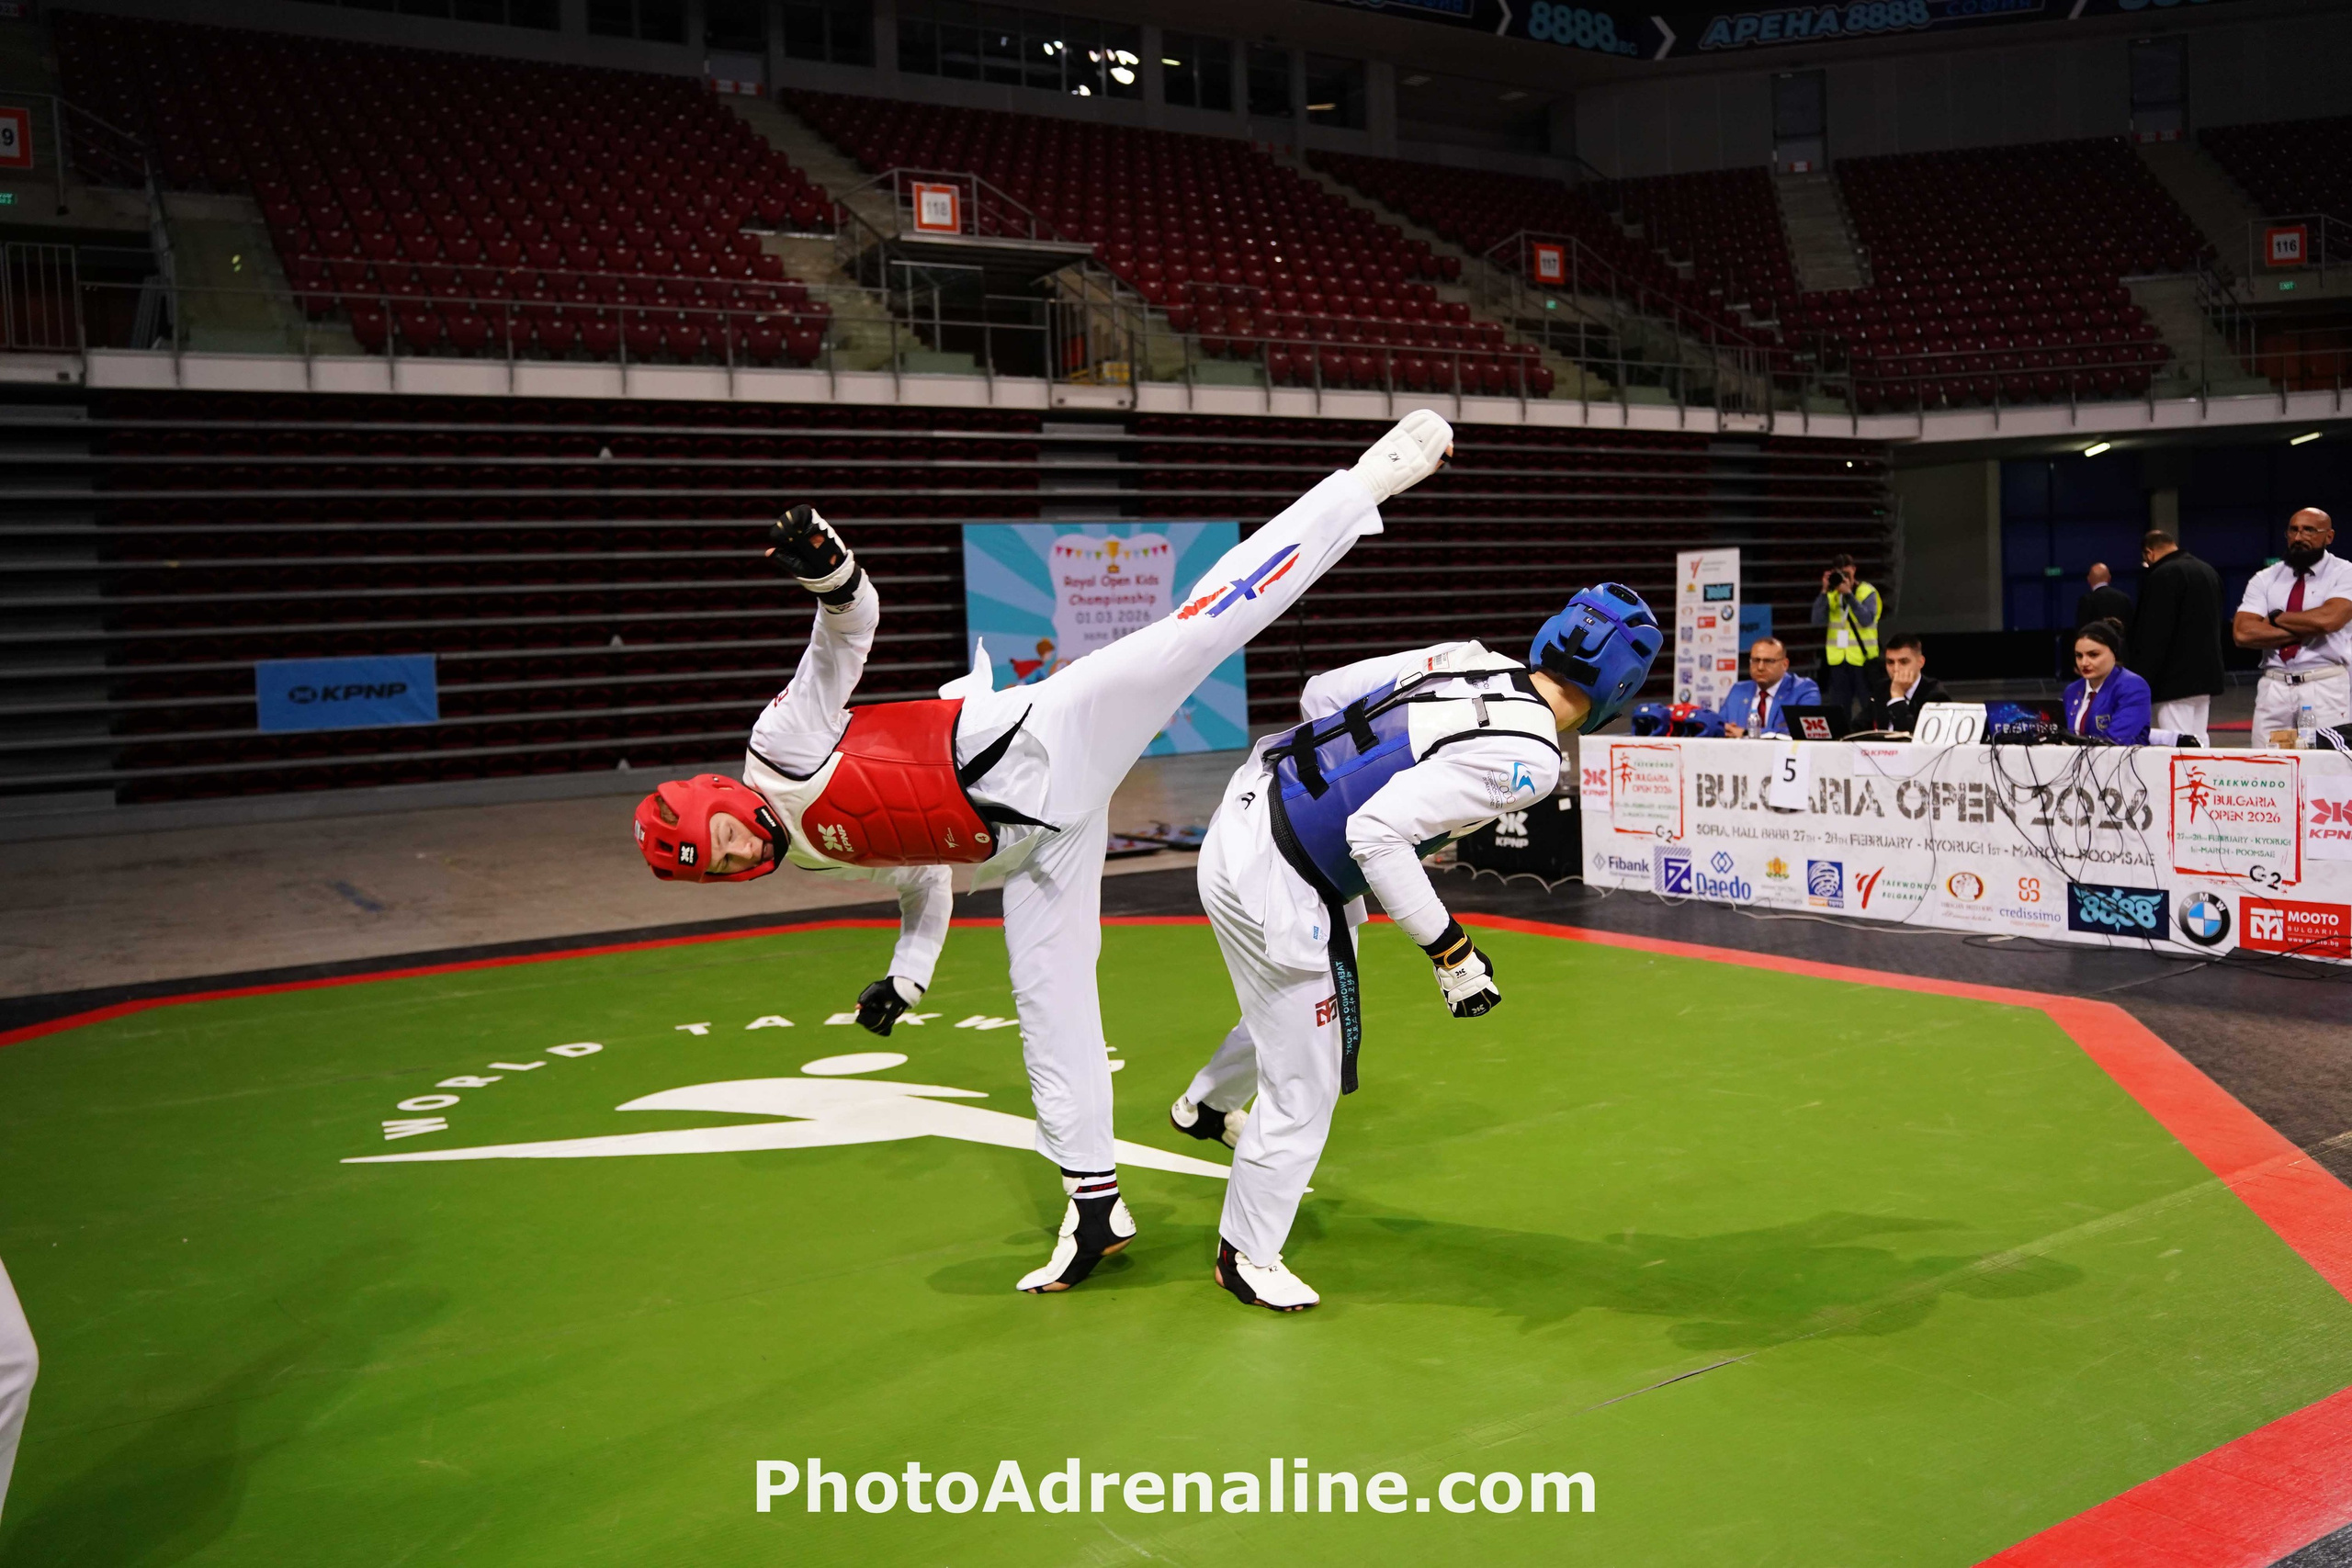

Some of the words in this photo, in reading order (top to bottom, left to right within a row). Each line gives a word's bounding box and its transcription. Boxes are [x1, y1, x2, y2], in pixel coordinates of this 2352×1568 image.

[1844, 0, 1930, 33] 8888
[2277, 239, 2297, 253] 116
[1064, 575, 1096, 590] Royal
[1101, 575, 1130, 590] Open
[1135, 575, 1159, 585] Kids
[1069, 592, 1157, 607] Championship
[1075, 610, 1151, 624] 01.03.2026
[322, 682, 407, 703] KPNP
[1922, 716, 1941, 744] 0
[1956, 716, 1975, 744] 0
[1782, 758, 1796, 782] 5
[2212, 779, 2285, 788] TAEKWONDO
[1896, 780, 2016, 825] OPEN
[2030, 785, 2153, 831] 2026
[2213, 795, 2278, 807] BULGARIA
[2209, 809, 2244, 822] OPEN
[2247, 811, 2280, 823] 2026
[836, 823, 854, 852] KPNP
[1732, 827, 1758, 840] HALL
[1849, 833, 1913, 850] FEBRUARY
[2208, 834, 2248, 843] FEBRUARY
[2255, 837, 2291, 846] KYORUGI
[2308, 829, 2352, 840] KPN
[2235, 849, 2276, 858] POOMSAE
[1608, 855, 1650, 873] Fibank
[1882, 879, 1937, 891] TAEKWONDO
[2249, 865, 2281, 890] G2
[1696, 872, 1752, 900] Daedo
[1883, 893, 1924, 902] BULGARIA
[1999, 907, 2062, 923] credissimo
[2288, 910, 2339, 926] MOOTO
[2288, 925, 2339, 936] BULGARIA
[381, 1041, 609, 1141] WORLD
